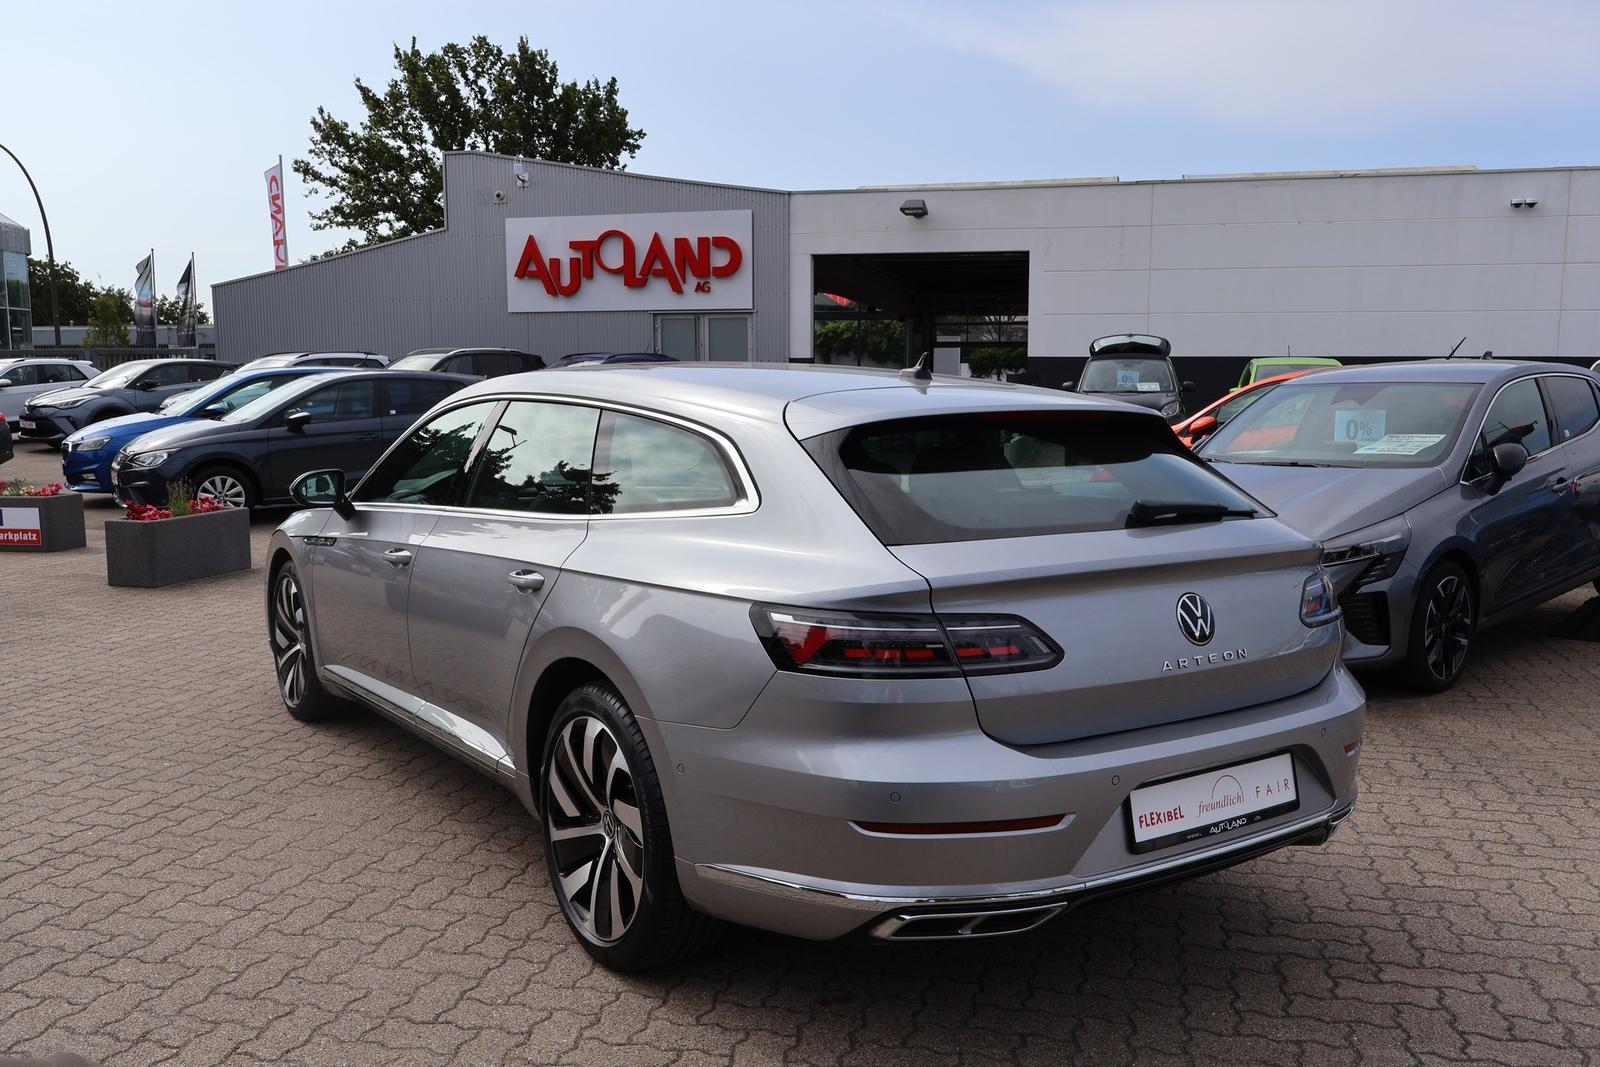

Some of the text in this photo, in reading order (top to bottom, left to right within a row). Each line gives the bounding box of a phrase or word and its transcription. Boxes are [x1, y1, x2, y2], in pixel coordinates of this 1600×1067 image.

[514, 229, 743, 297] AUTOLAND
[694, 281, 711, 293] AG
[1345, 419, 1372, 441] 0%
[1161, 648, 1248, 672] ARTEON
[1138, 778, 1290, 829] FLEXIBEL freundlich FAIR
[1209, 817, 1247, 834] AUTOLAND
